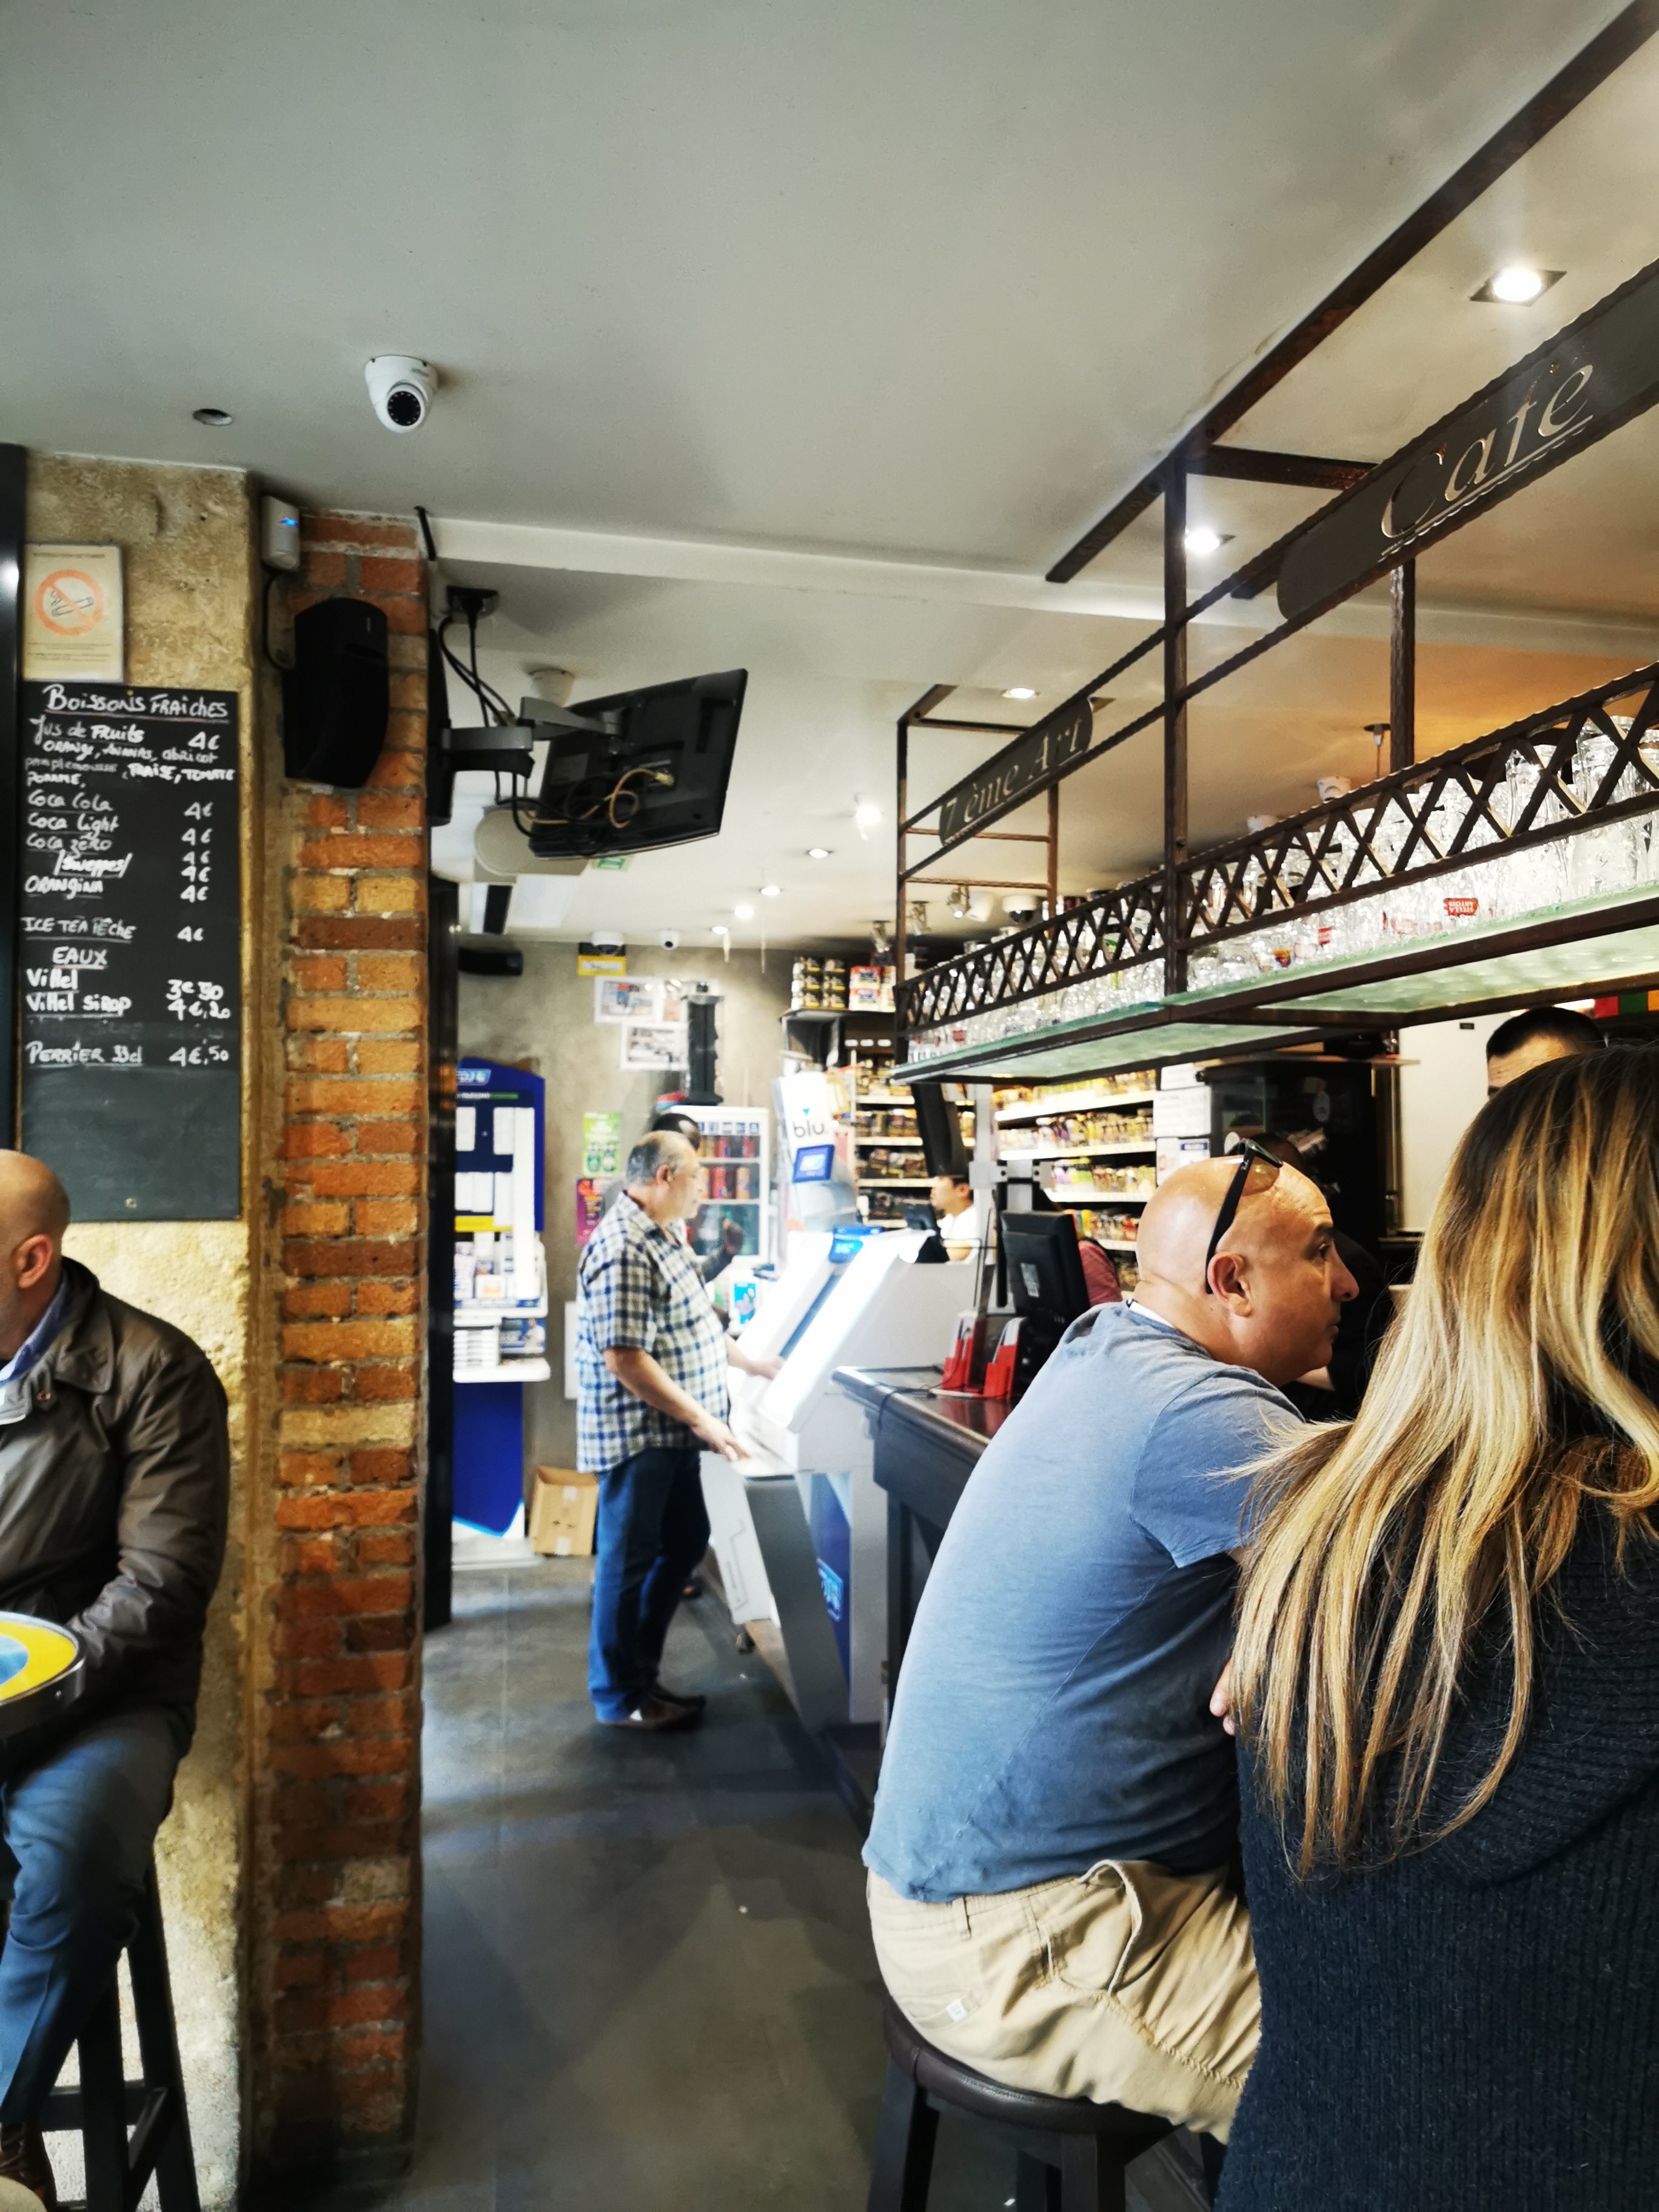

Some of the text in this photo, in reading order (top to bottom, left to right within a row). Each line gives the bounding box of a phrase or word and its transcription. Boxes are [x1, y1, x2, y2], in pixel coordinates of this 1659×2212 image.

[21, 916, 55, 933] ICE
[52, 945, 108, 966] EAUX
[793, 1121, 825, 1138] blu
